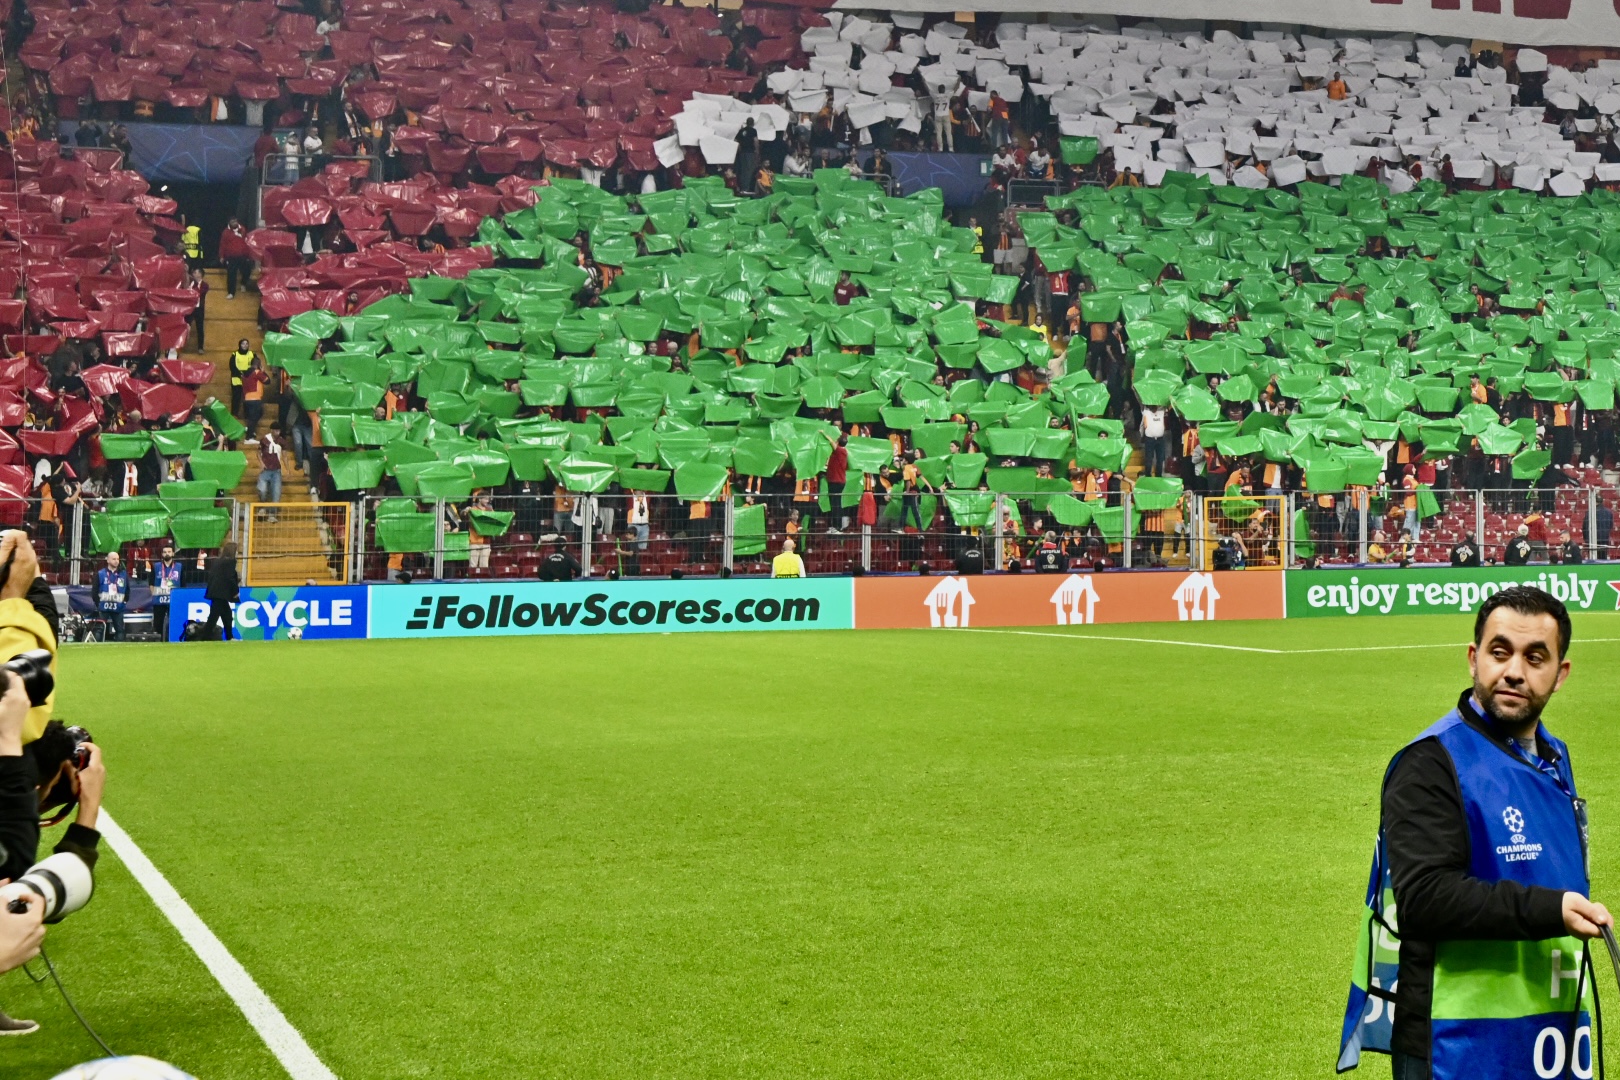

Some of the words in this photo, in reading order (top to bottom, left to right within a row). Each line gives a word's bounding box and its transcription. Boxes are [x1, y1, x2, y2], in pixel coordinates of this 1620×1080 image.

[103, 602, 118, 610] 023
[1307, 576, 1400, 615] enjoy
[188, 599, 353, 629] RCYCLE
[432, 593, 821, 630] FollowScores.com
[1496, 843, 1543, 855] CHAMPIONS
[1505, 852, 1537, 862] LEAGUE
